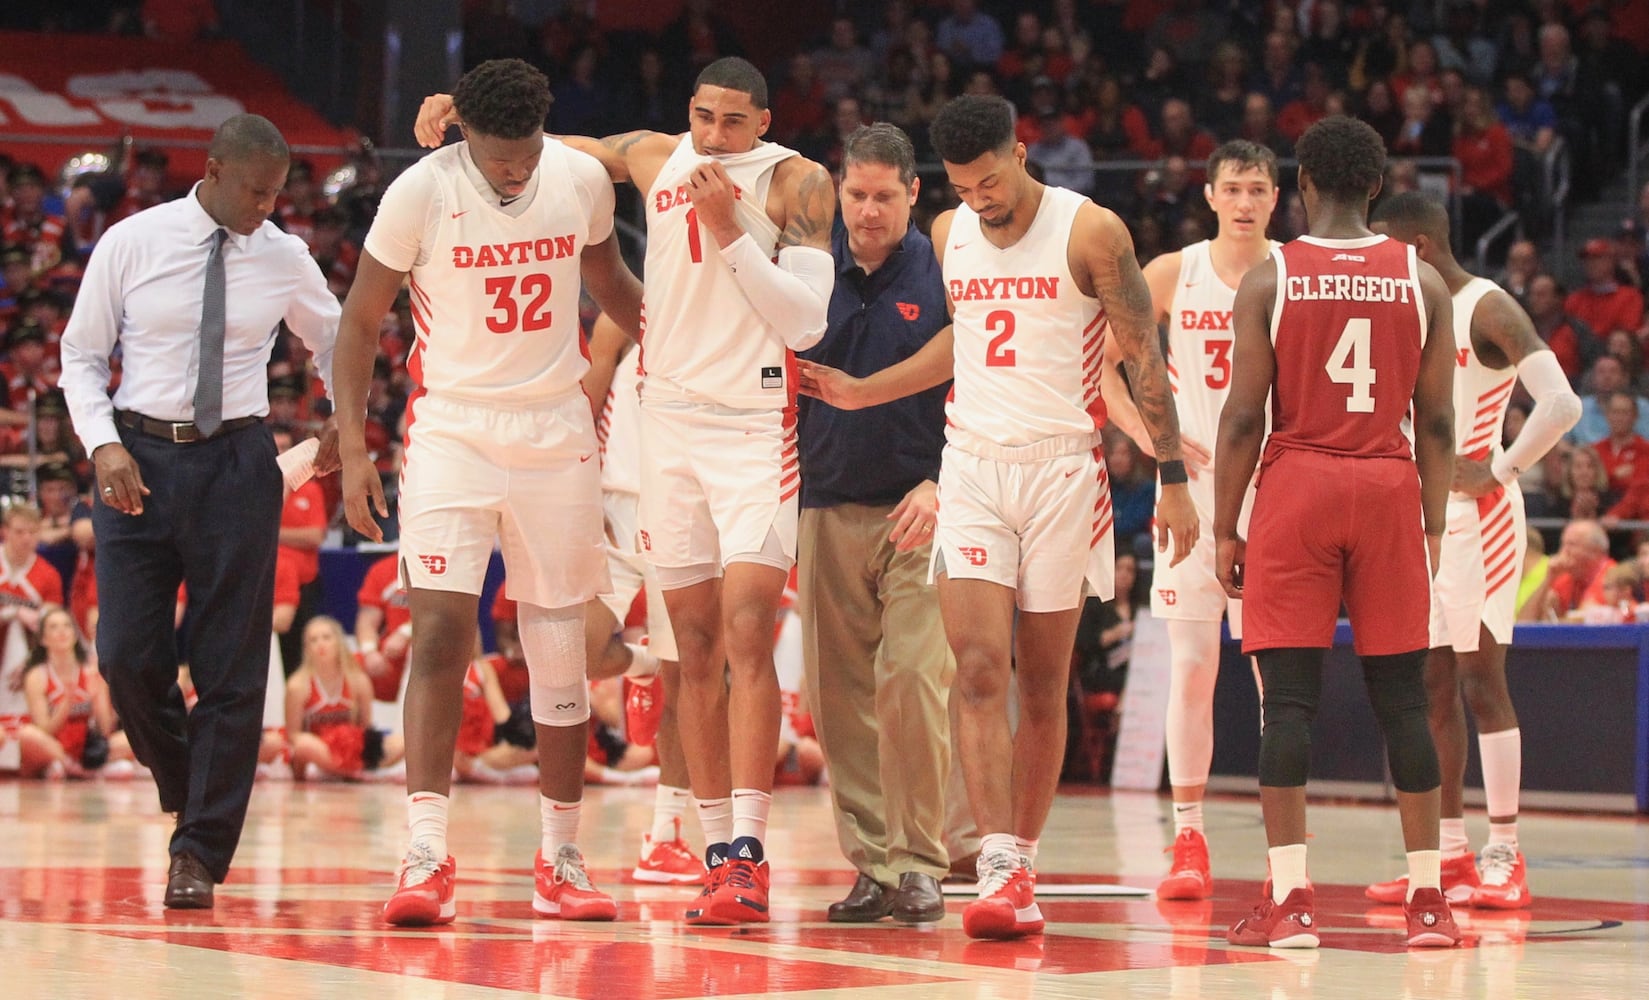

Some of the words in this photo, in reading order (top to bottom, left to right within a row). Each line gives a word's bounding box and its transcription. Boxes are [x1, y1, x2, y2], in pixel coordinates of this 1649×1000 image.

[451, 234, 576, 269] DAYTON
[685, 207, 703, 263] 1
[485, 273, 552, 334] 32
[949, 277, 1060, 302] DAYTON
[1287, 275, 1413, 304] CLERGEOT
[985, 309, 1016, 368] 2
[1181, 310, 1235, 330] DAY
[1324, 317, 1377, 413] 4
